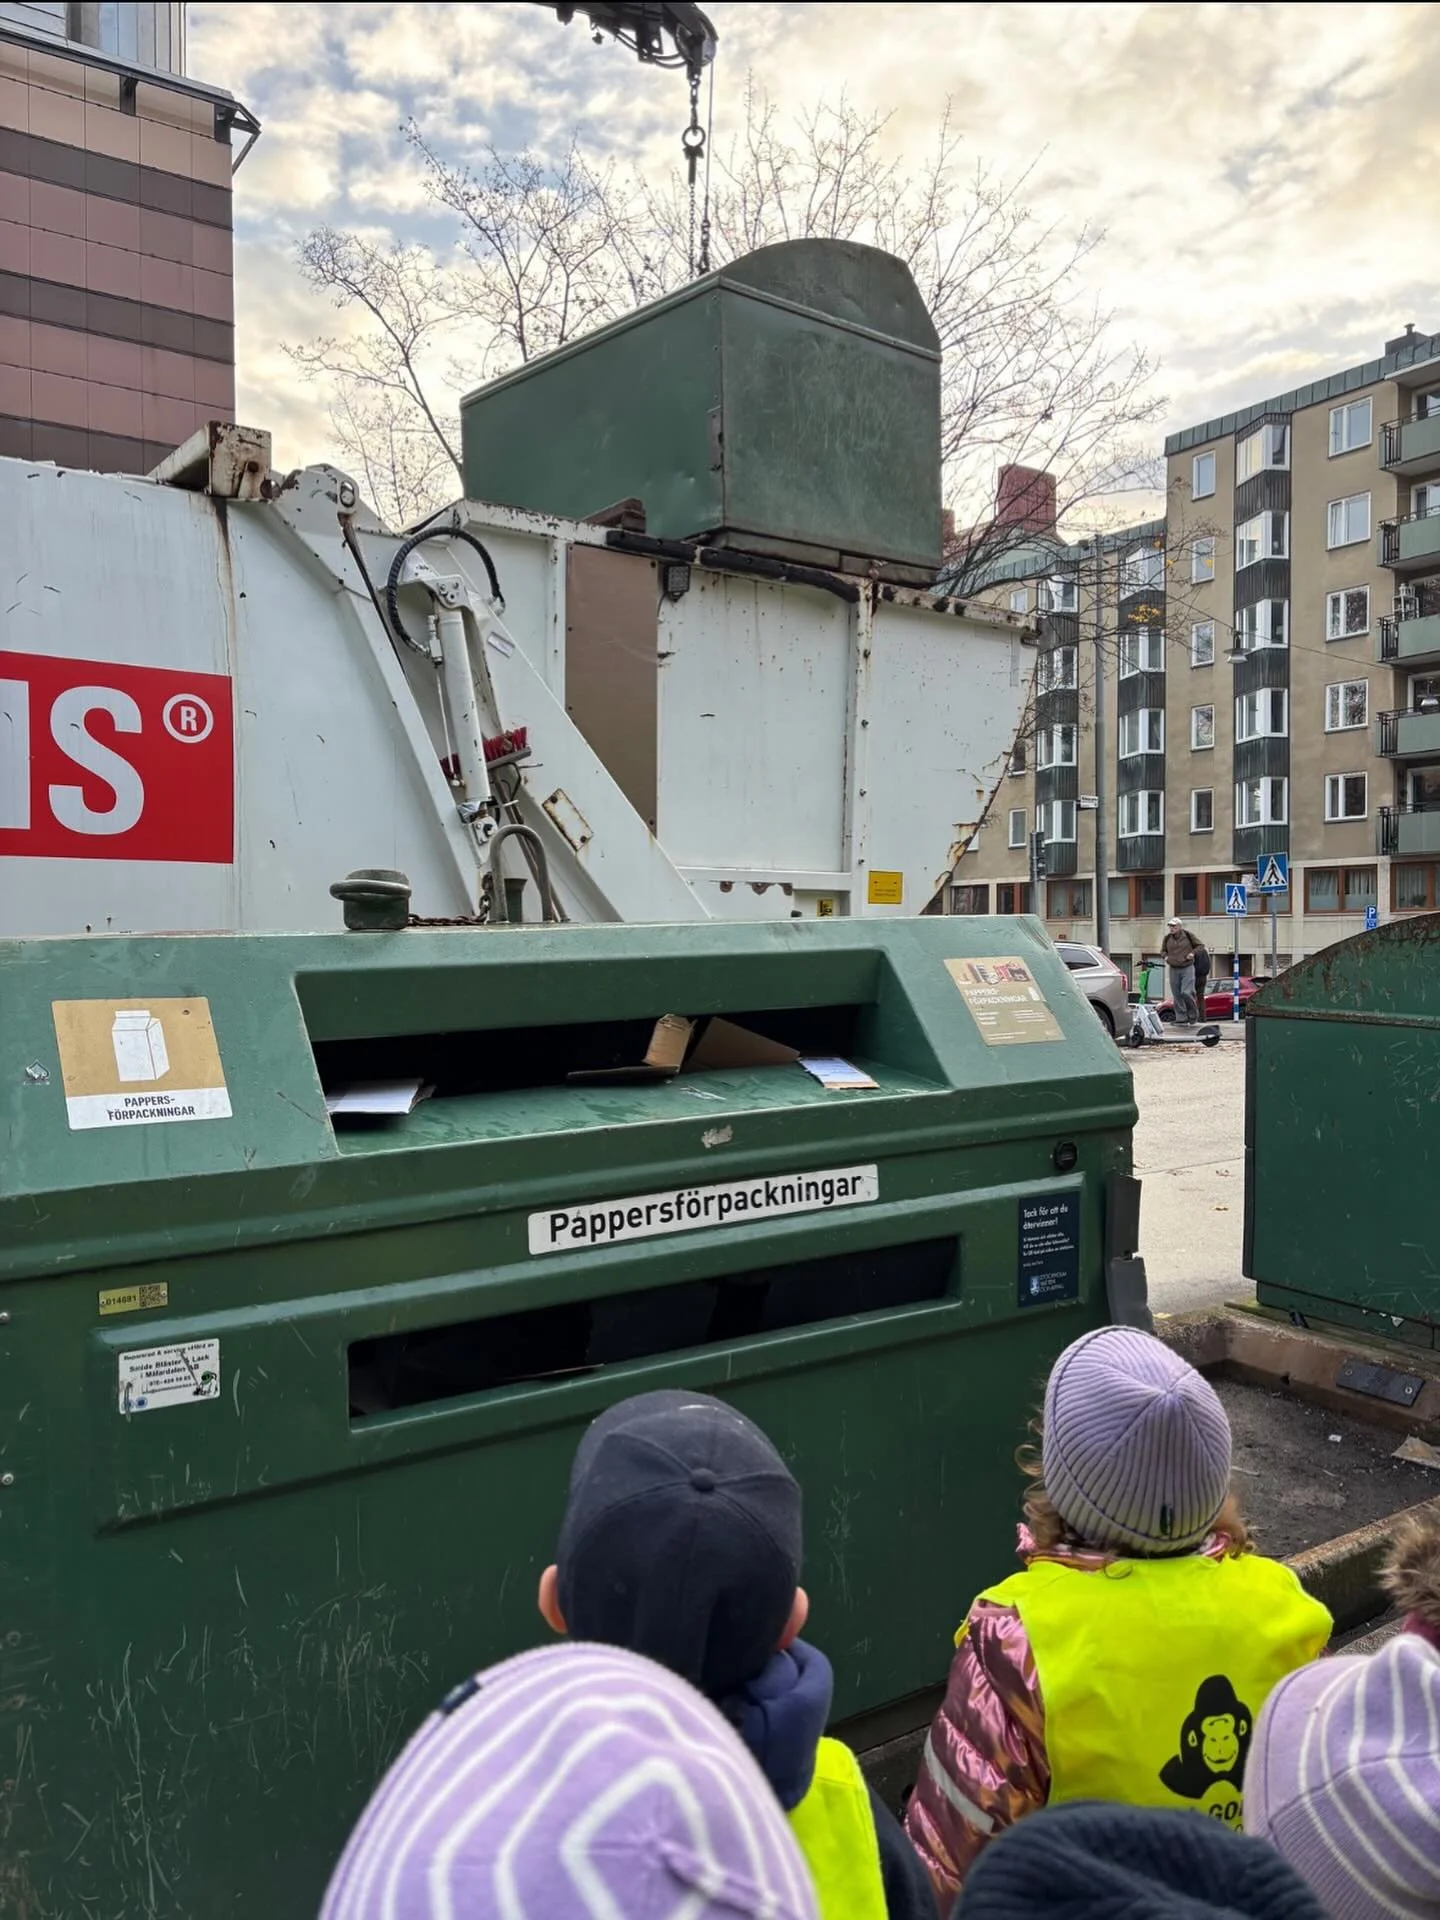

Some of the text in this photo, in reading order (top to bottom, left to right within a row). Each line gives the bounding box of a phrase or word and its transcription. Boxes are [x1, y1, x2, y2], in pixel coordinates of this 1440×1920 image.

[1368, 907, 1376, 918] P
[124, 1095, 175, 1107] PAPPERS-
[107, 1106, 195, 1120] FÖRPACKNINGAR
[549, 1175, 863, 1243] Pappersförpackningar
[1023, 1203, 1068, 1218] Tack för att du
[192, 1354, 210, 1363] Lack
